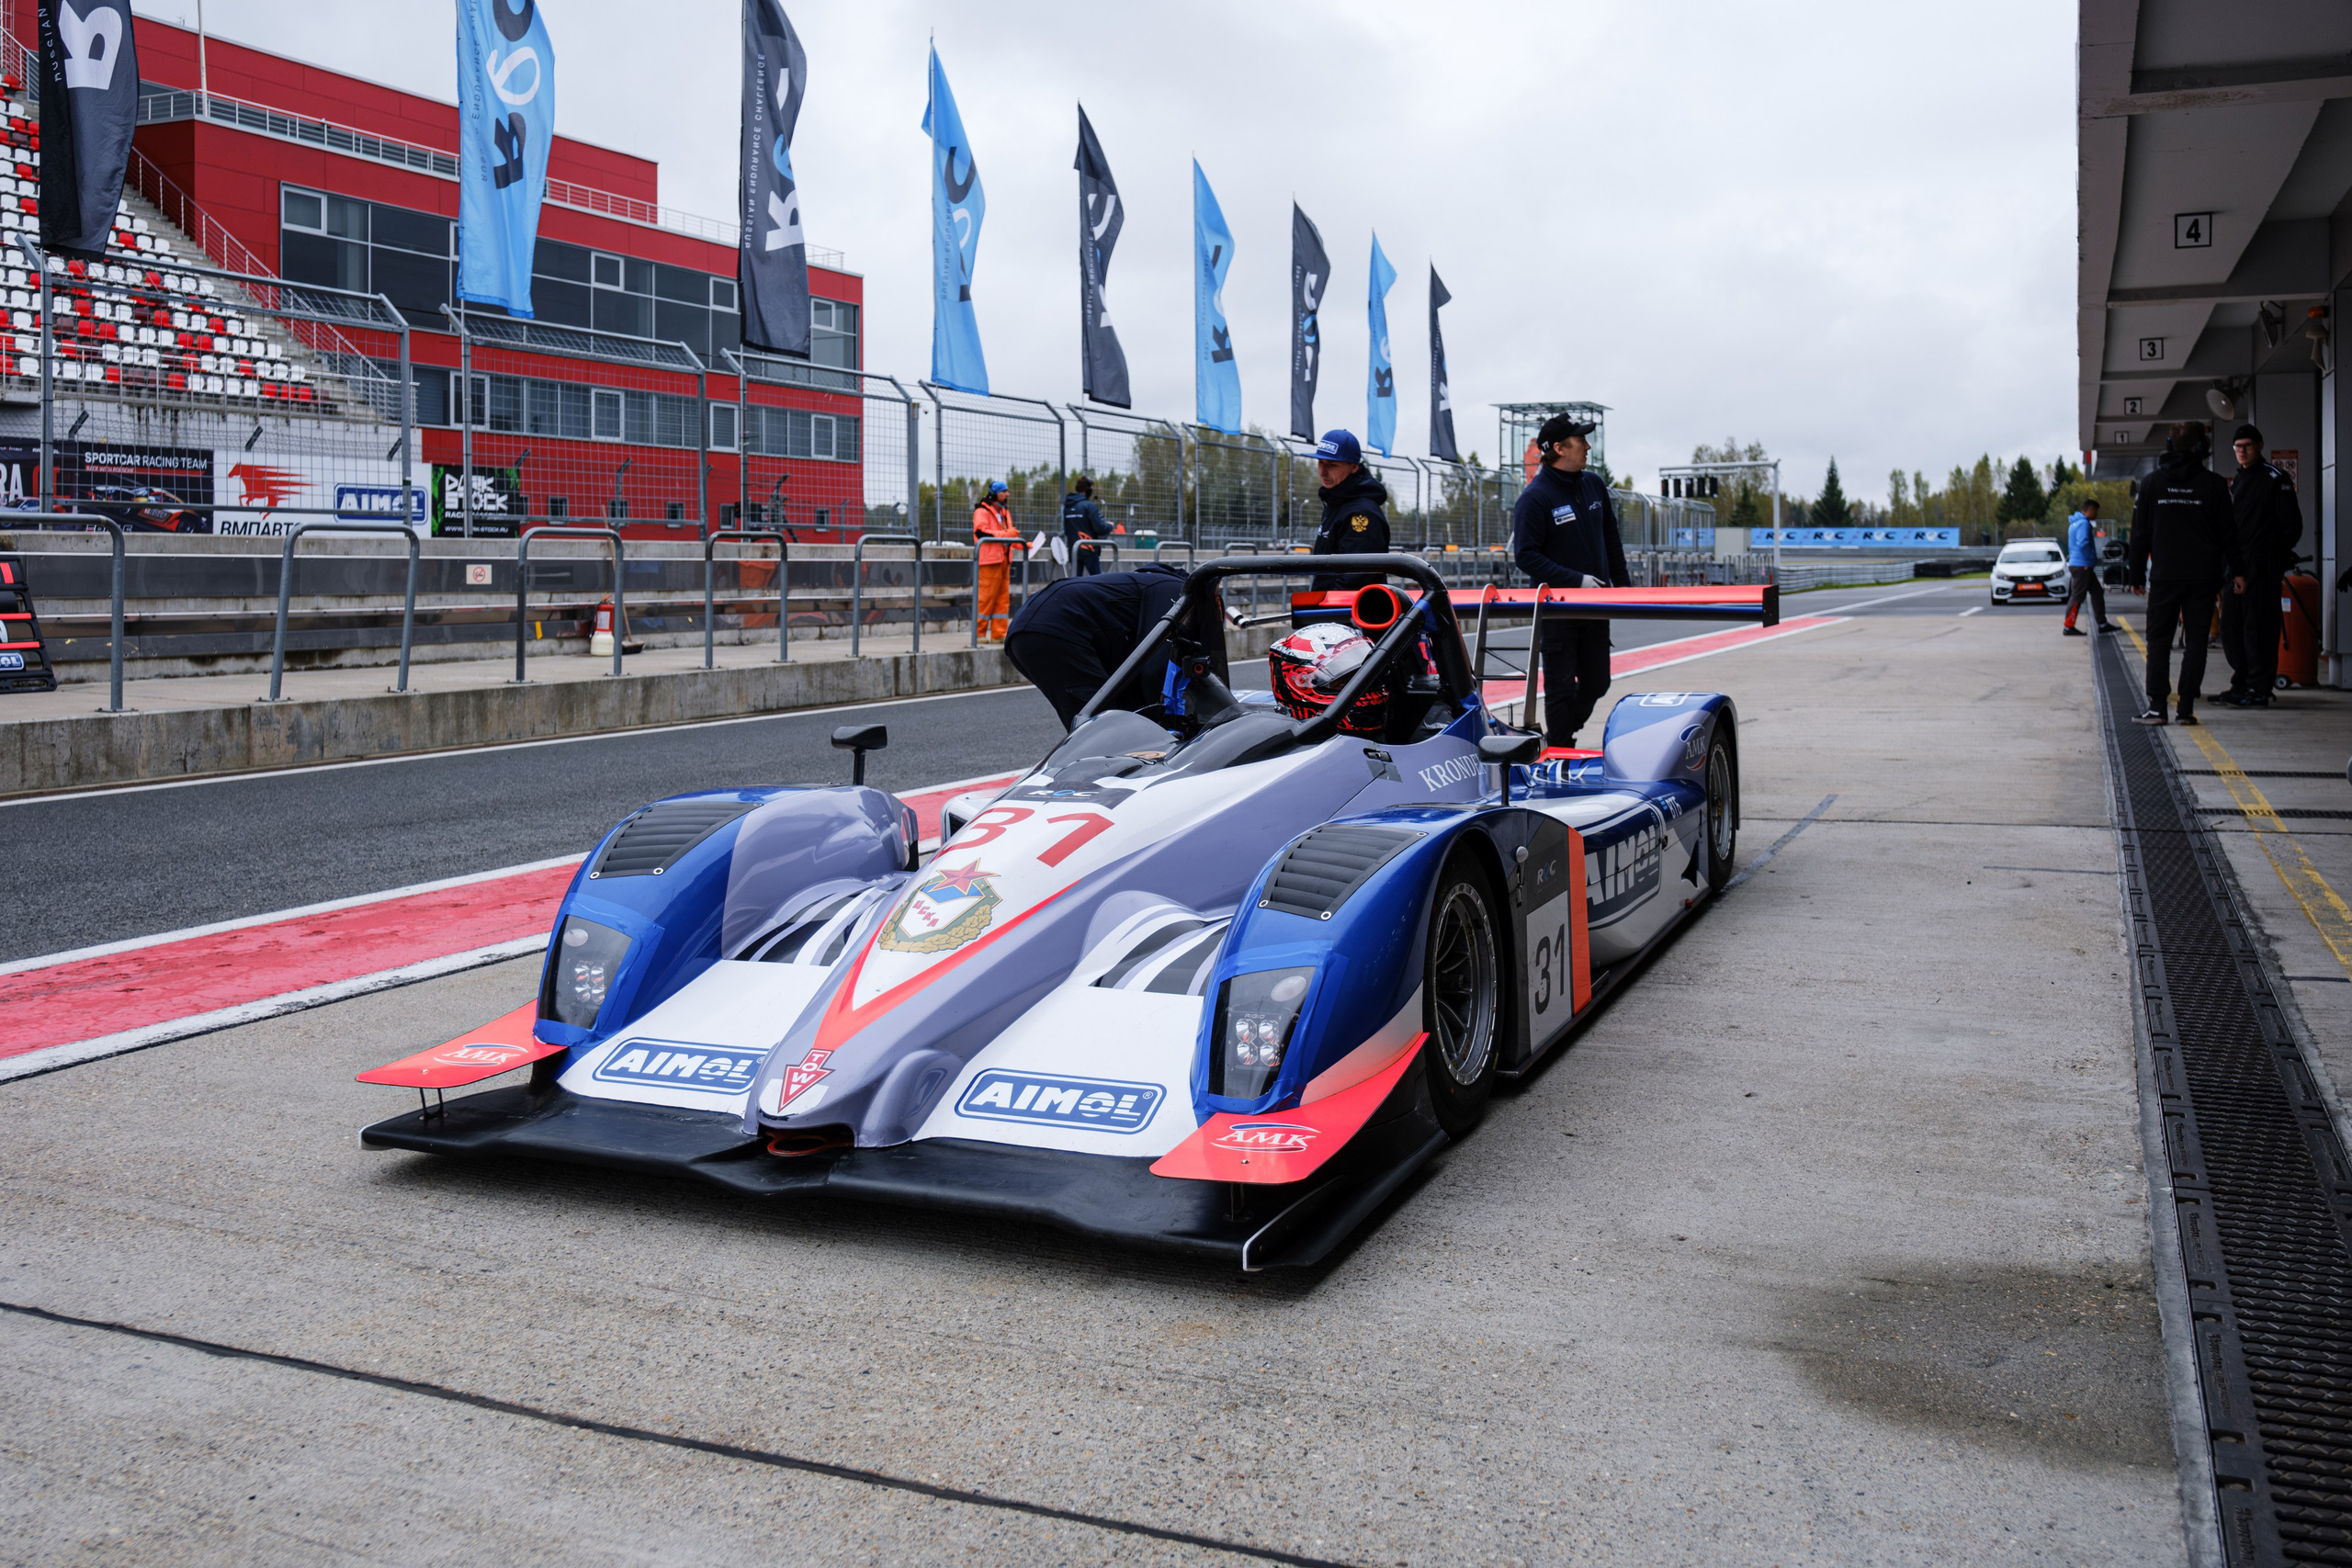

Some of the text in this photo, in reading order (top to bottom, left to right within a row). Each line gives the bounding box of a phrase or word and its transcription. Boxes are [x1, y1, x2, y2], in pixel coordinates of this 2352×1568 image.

[2186, 219, 2200, 243] 4
[2147, 342, 2156, 357] 3
[2130, 401, 2137, 412] 2
[2120, 434, 2124, 442] 1
[85, 451, 208, 469] SPORTCAR RACING TEAM
[220, 521, 301, 536] ВМПАВТ
[1686, 736, 1706, 760] AMK
[1666, 795, 1682, 819] ВТБ
[929, 807, 1114, 868] 31
[1585, 825, 1659, 908] AIMOL
[912, 899, 940, 928] ЦСКА
[1534, 922, 1565, 1015] 31
[443, 1046, 522, 1066] AMK
[611, 1048, 753, 1083] AIMOL
[792, 1054, 825, 1084] TOW
[969, 1081, 1142, 1121] AIMOL
[1217, 1130, 1317, 1147] AMK
